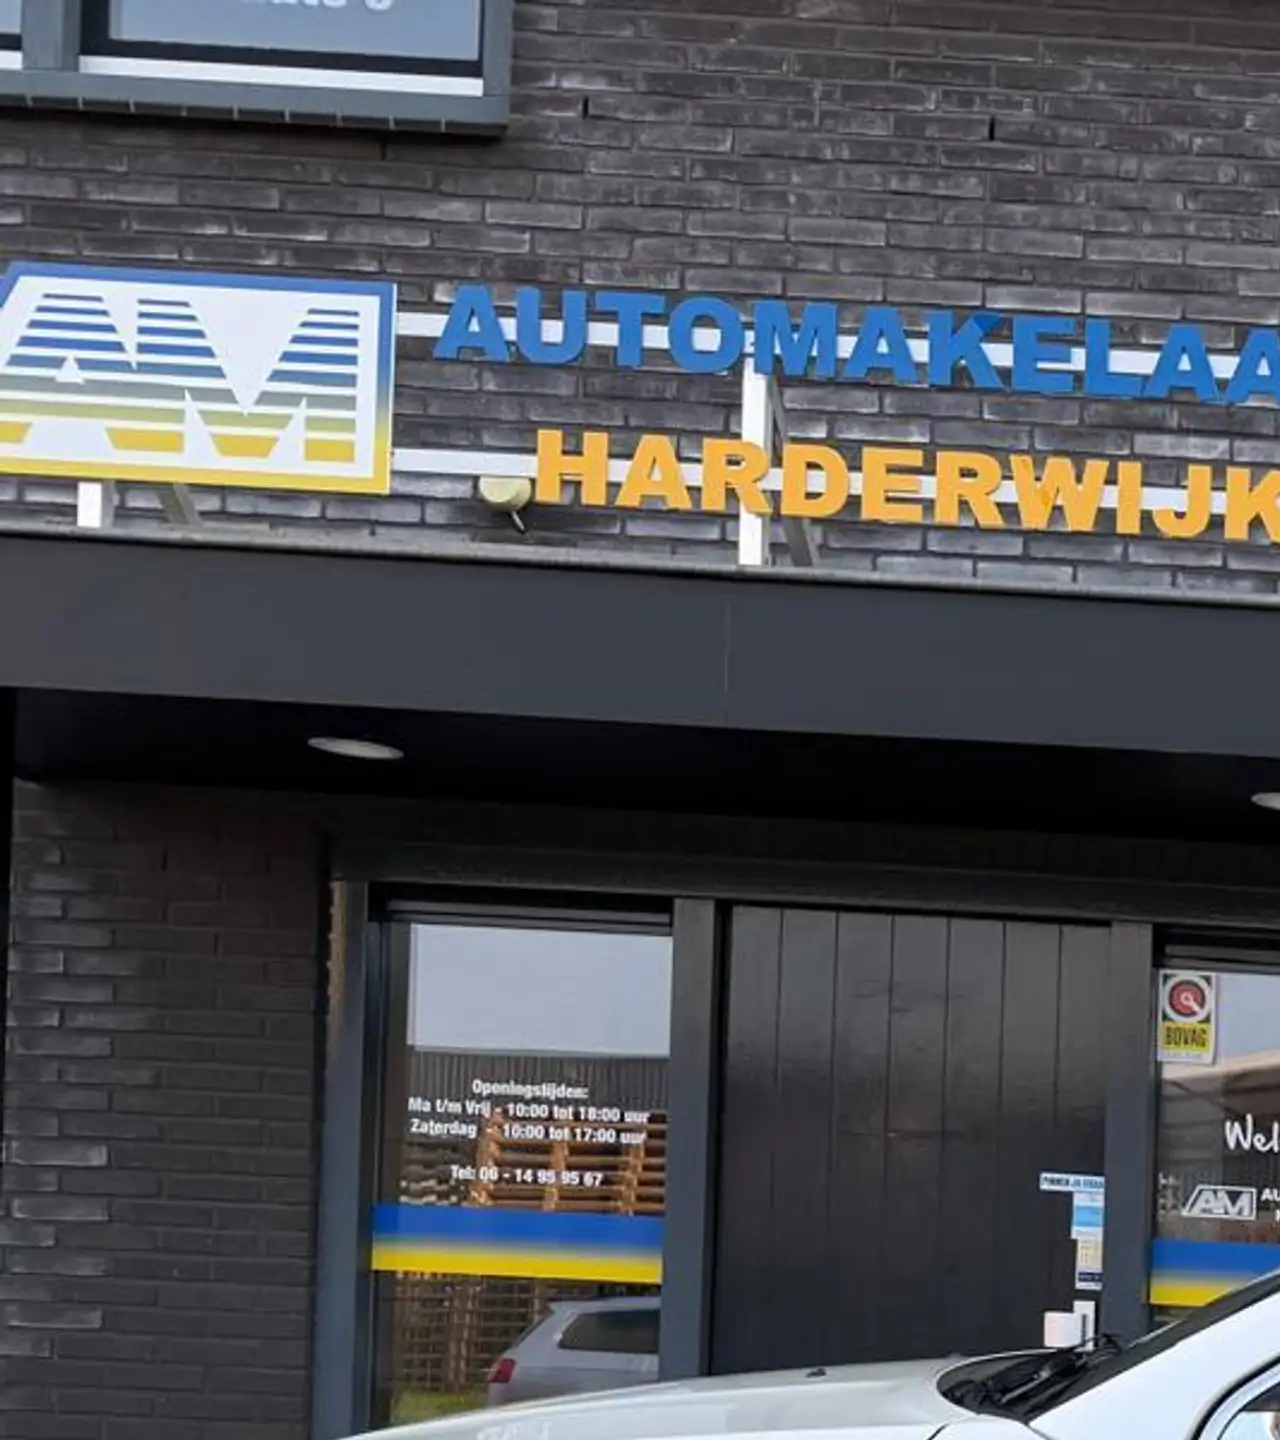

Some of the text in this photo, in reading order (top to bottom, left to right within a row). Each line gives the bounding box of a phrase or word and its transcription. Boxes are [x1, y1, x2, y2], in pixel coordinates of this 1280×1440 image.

[1164, 1025, 1207, 1048] BOVAG
[408, 1096, 431, 1113] Ma
[465, 1099, 491, 1118] Vrij
[507, 1102, 549, 1120] 10:00
[553, 1104, 574, 1121] tot
[579, 1105, 621, 1122] 18:00
[624, 1110, 650, 1125] uur
[410, 1118, 478, 1139] Zaterdag
[503, 1124, 546, 1141] 10:00
[549, 1126, 570, 1142] tot
[575, 1127, 616, 1143] 17:00
[619, 1131, 646, 1146] uur
[479, 1166, 499, 1181] 06
[515, 1168, 534, 1184] 14
[561, 1170, 580, 1186] 95
[583, 1171, 604, 1188] 67
